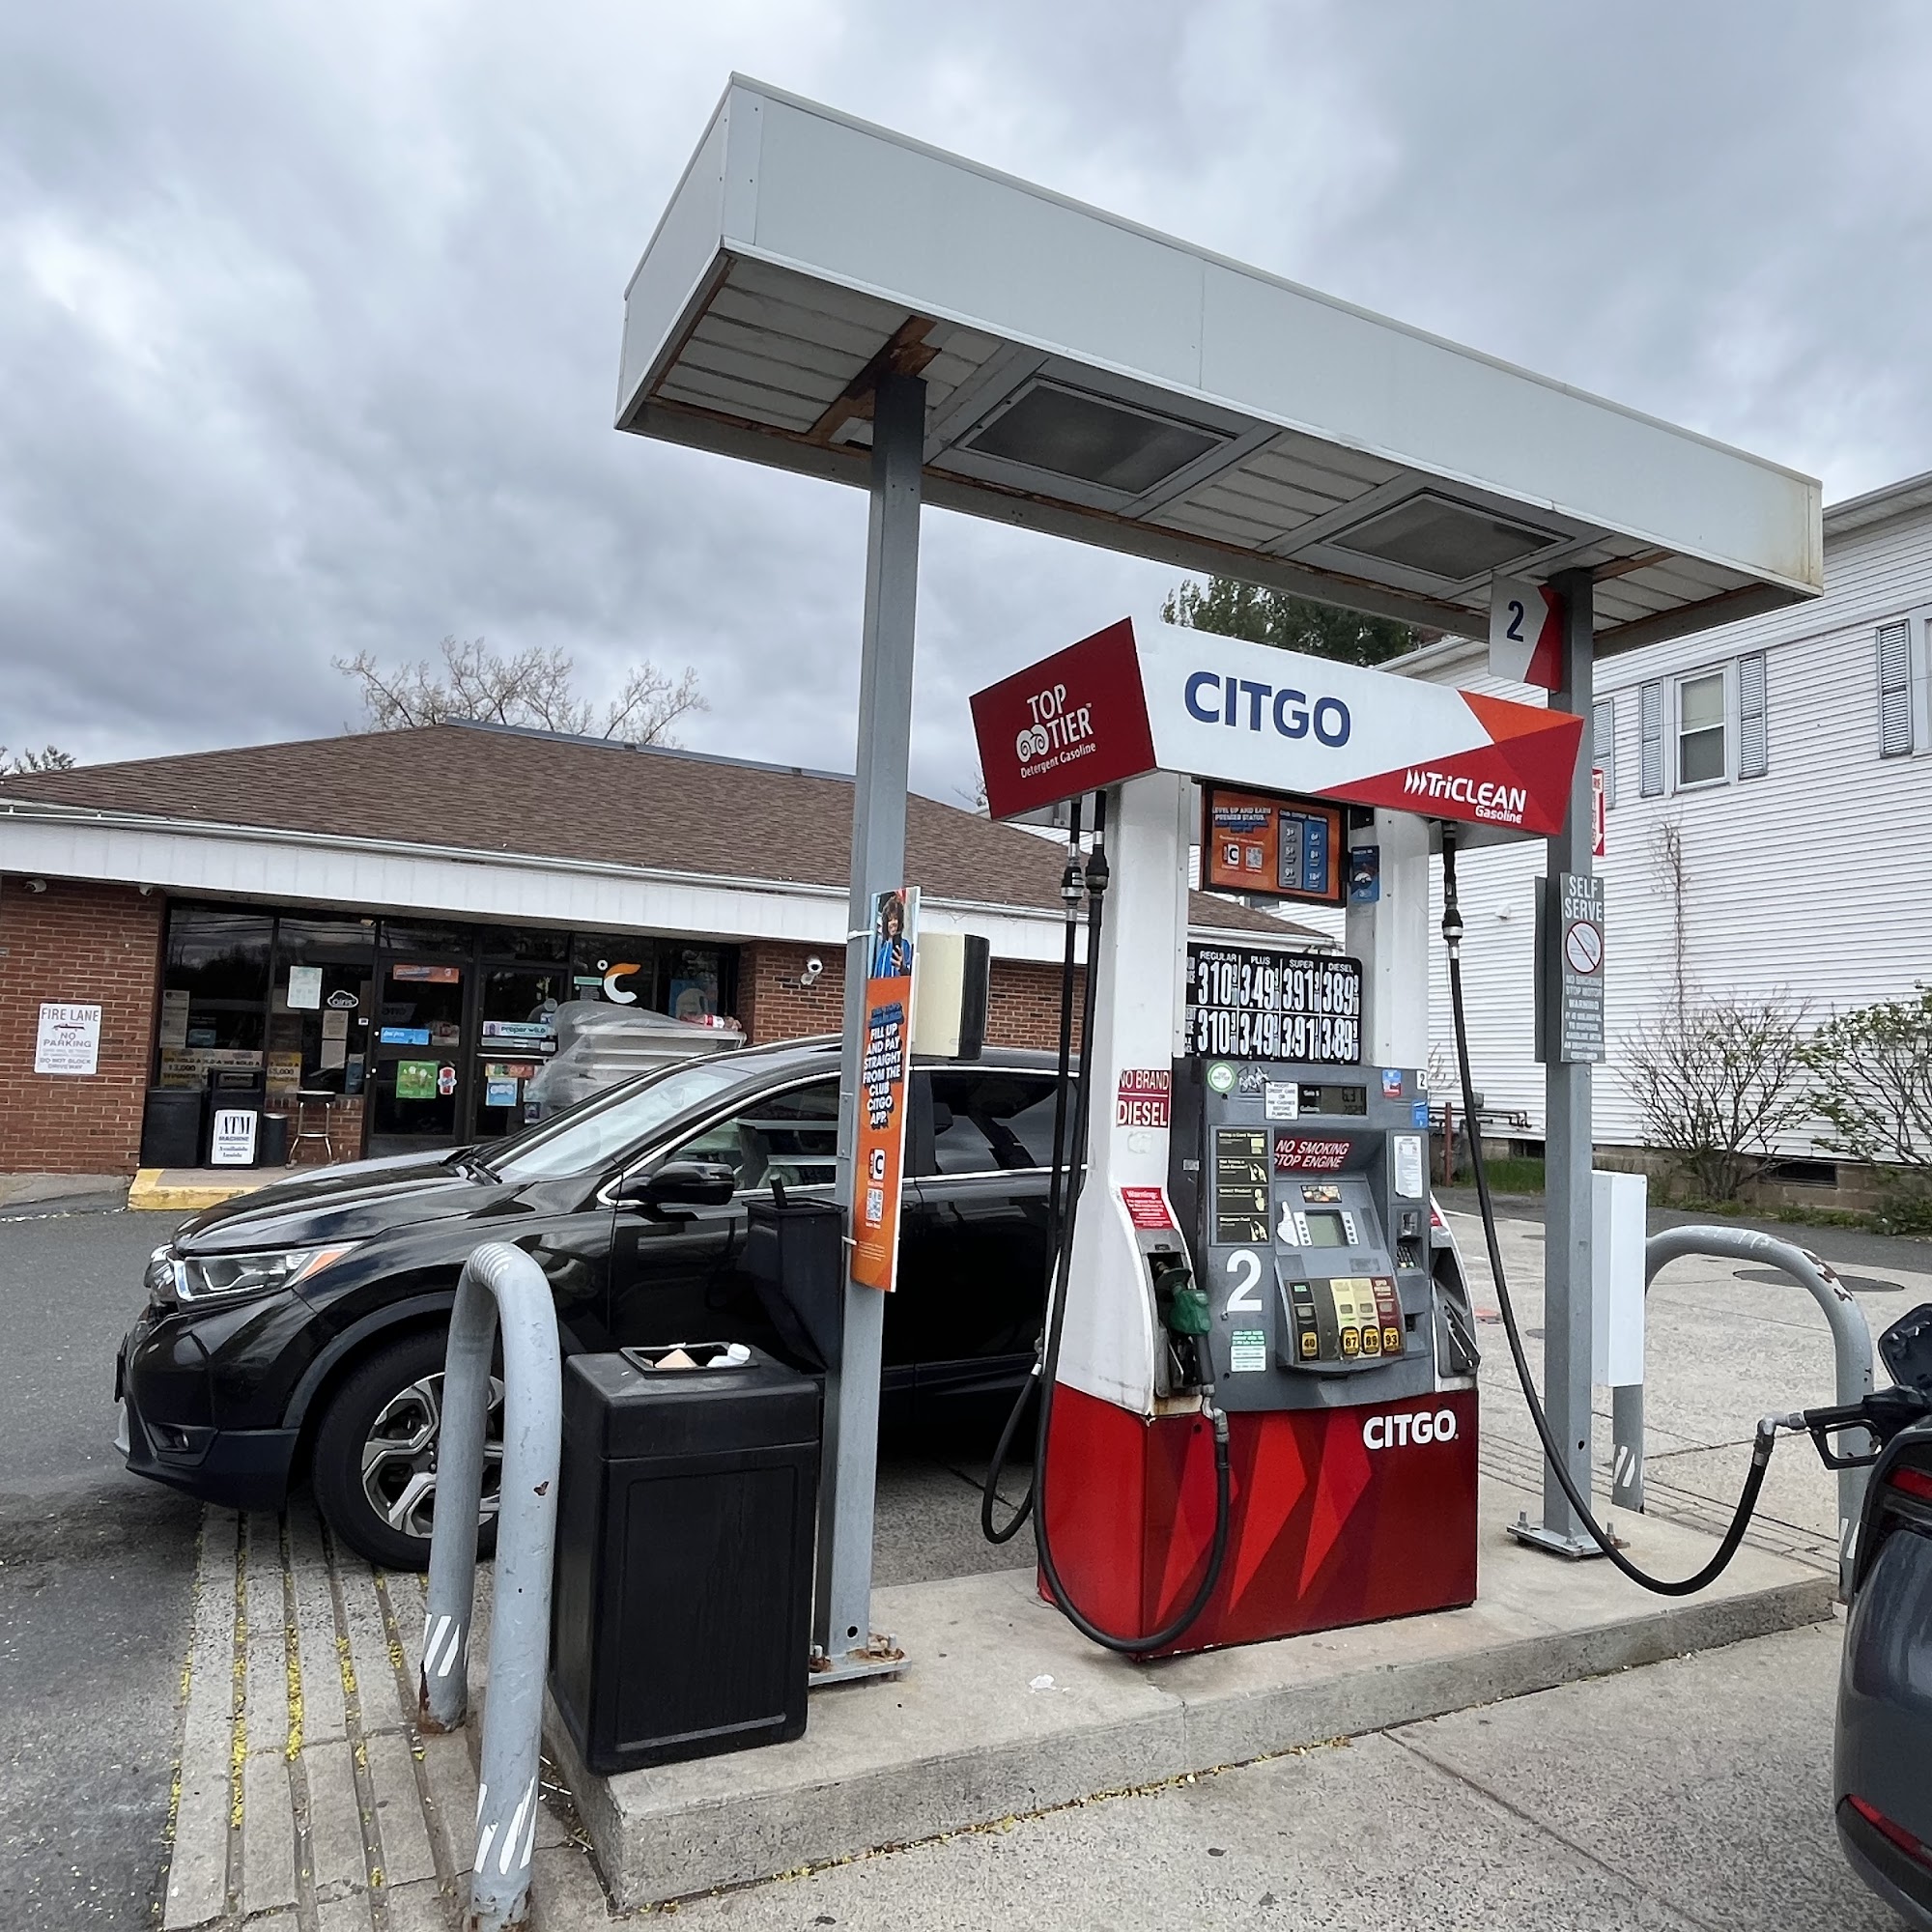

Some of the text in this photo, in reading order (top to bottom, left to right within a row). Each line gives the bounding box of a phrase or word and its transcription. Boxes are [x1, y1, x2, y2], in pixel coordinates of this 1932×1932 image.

[1507, 600, 1524, 642] 2
[1026, 684, 1066, 724] TOP
[1184, 671, 1350, 748] CITGO
[1046, 707, 1094, 749] TIER
[1020, 743, 1096, 778] Detergent Gasoline
[1427, 772, 1526, 812] TriCLEAN
[1475, 805, 1522, 824] Gasoline
[1569, 875, 1599, 898] SELF
[1564, 896, 1603, 922] SERVE
[1200, 951, 1236, 962] REGULAR
[1251, 955, 1271, 965] PLUS
[1289, 959, 1314, 968] SUPER
[1327, 962, 1353, 973] DIESEL
[1566, 985, 1581, 995] STOP
[42, 1008, 99, 1022] FIRE LANE
[60, 1032, 76, 1040] NO
[870, 1023, 898, 1041] FILL UP
[43, 1039, 92, 1048] PARKING
[867, 1036, 900, 1056] AND PAY
[864, 1050, 902, 1071] STRAIGHT
[863, 1065, 901, 1083] FROM THE
[1120, 1069, 1169, 1091] NO BRAND
[1419, 1072, 1426, 1088] 2
[869, 1081, 890, 1097] CLUB
[867, 1095, 894, 1112] CITGO
[1117, 1099, 1168, 1126] DIESEL
[220, 1116, 251, 1134] ATM
[870, 1111, 888, 1125] APP.
[1275, 1140, 1350, 1155] NO SMOKING
[1302, 1155, 1344, 1168] ENGINE
[1226, 1249, 1263, 1312] 2
[1346, 1337, 1357, 1347] 87
[1385, 1334, 1398, 1345] 93
[1362, 1409, 1457, 1450] CITGO
